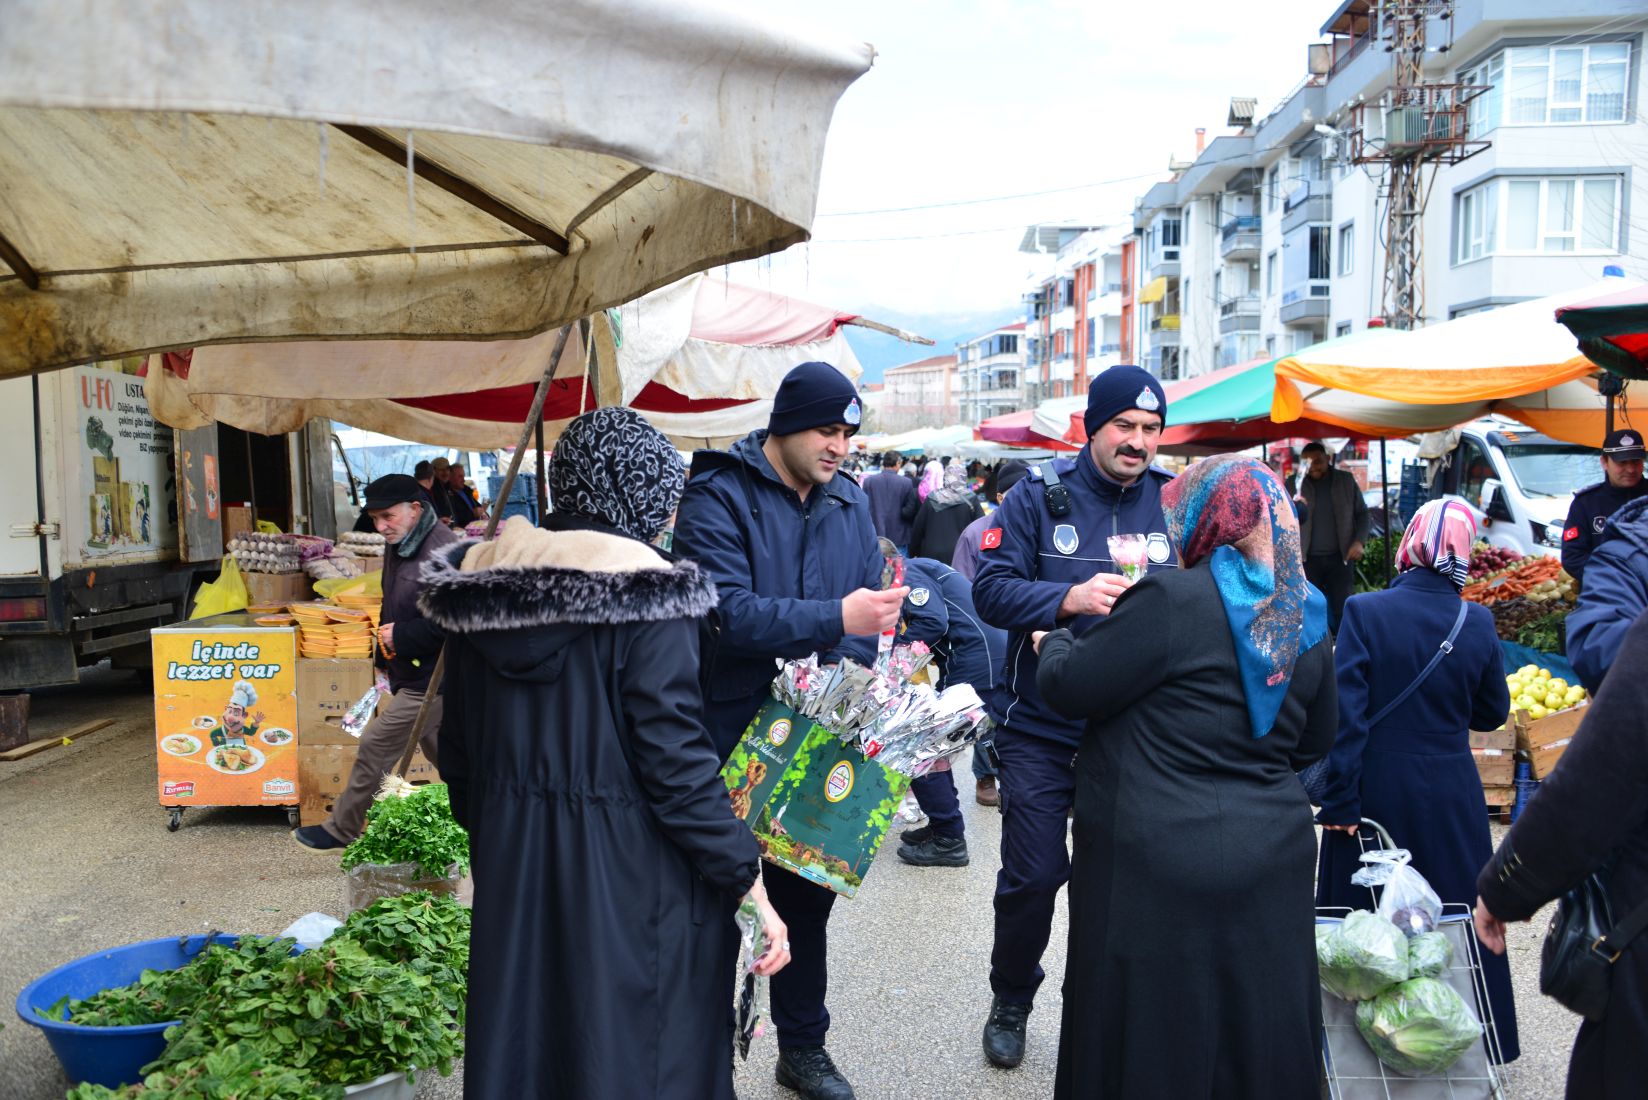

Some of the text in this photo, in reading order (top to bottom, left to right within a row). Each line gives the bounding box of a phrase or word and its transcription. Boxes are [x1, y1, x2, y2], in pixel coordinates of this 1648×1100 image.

[134, 418, 144, 428] gibi
[192, 640, 259, 664] İçinde
[167, 661, 281, 680] lezzet var
[265, 783, 292, 792] Banvit
